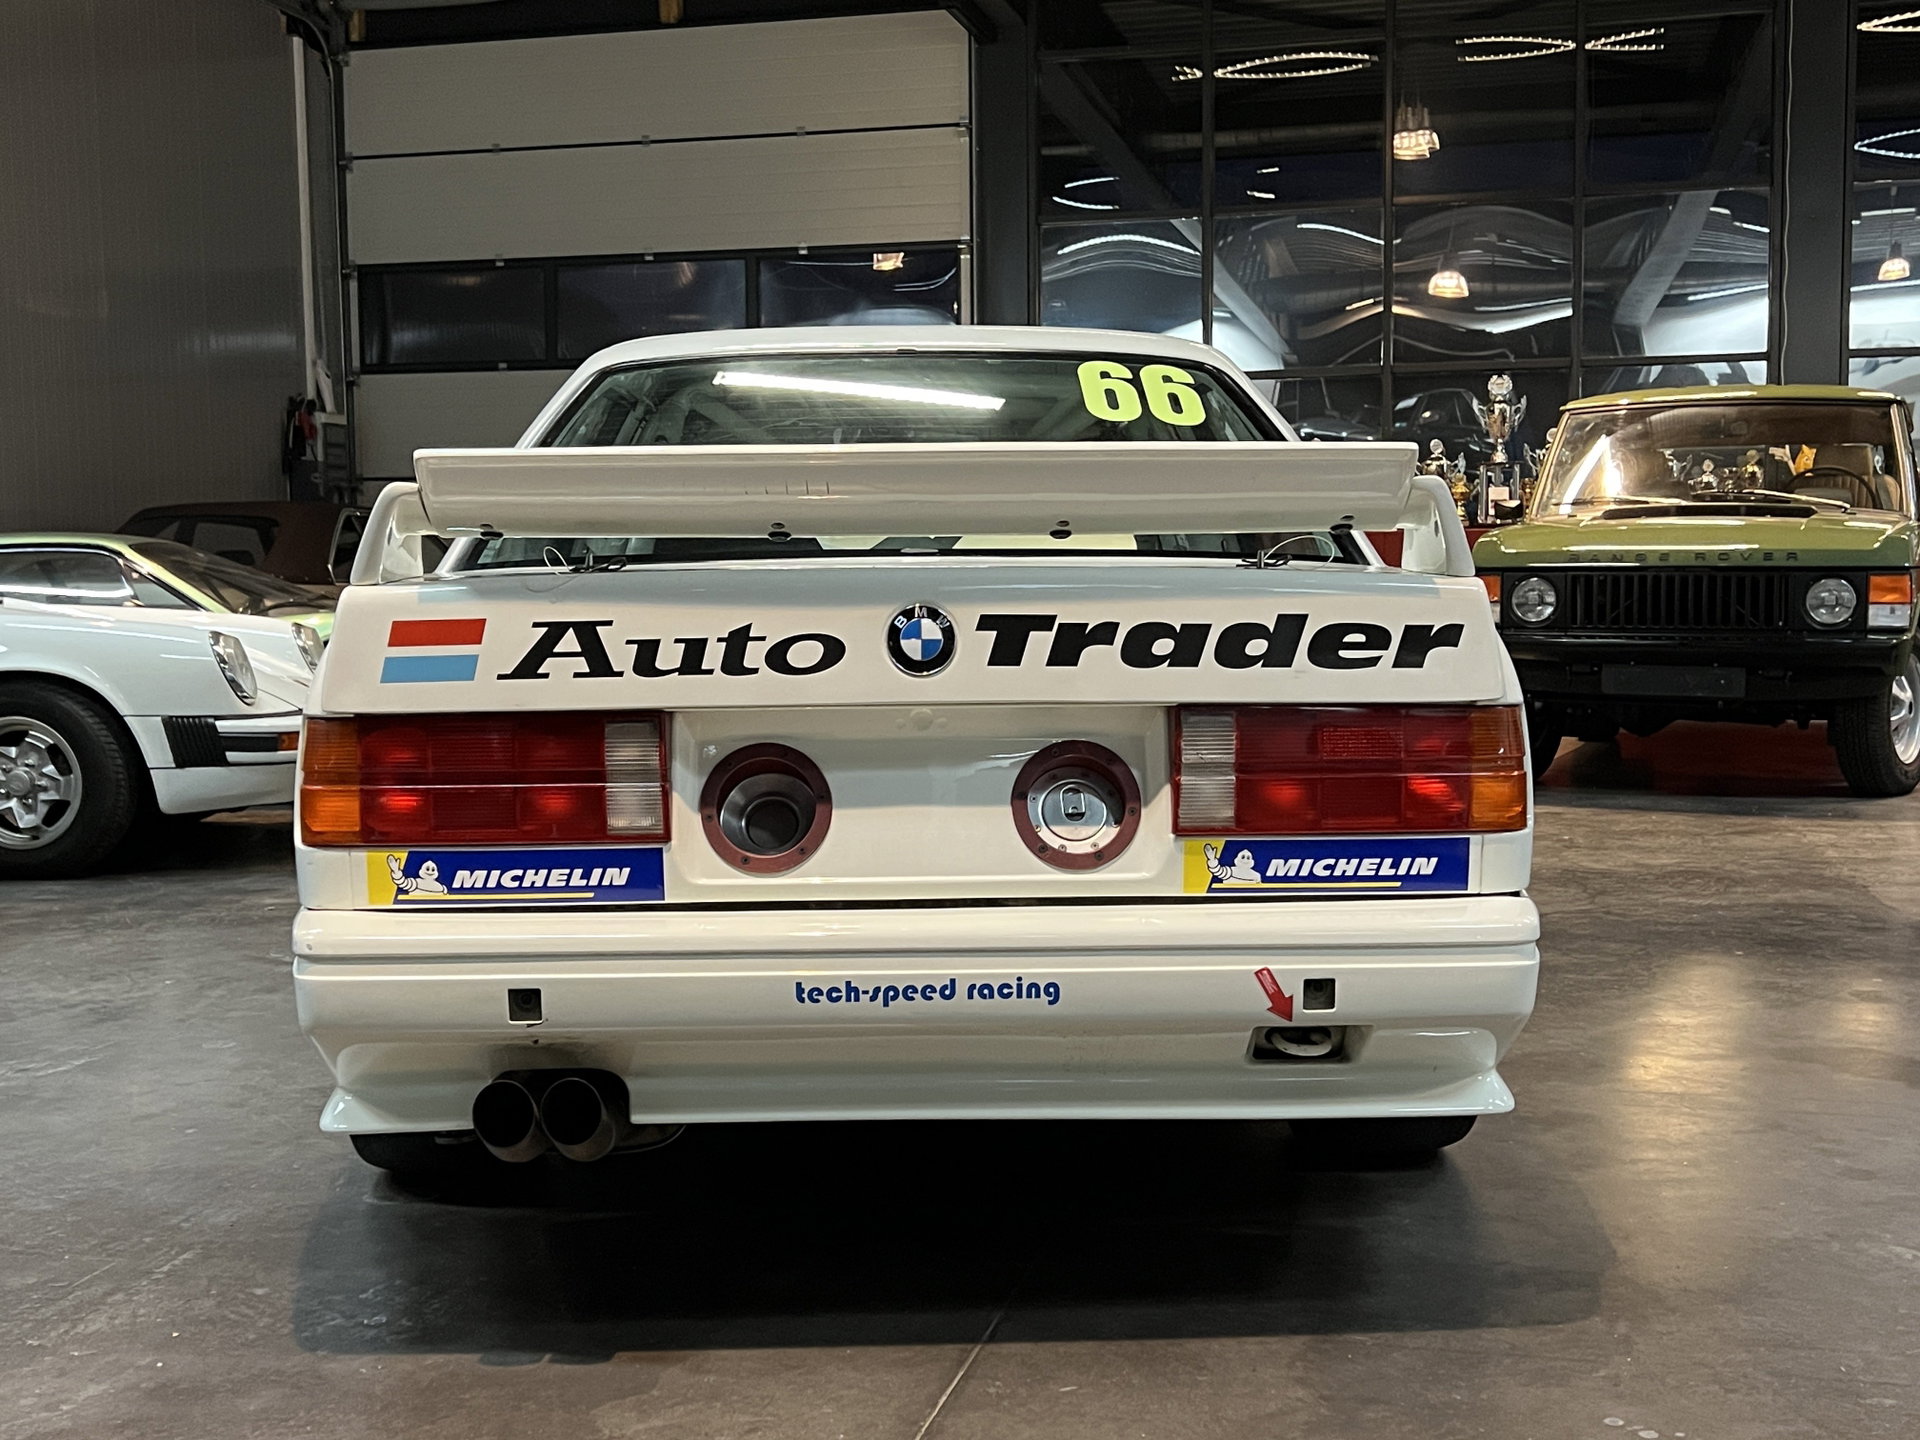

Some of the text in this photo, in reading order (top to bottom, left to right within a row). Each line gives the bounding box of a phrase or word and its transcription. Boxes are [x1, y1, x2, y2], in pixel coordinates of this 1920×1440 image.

[1077, 360, 1206, 426] 66
[1694, 551, 1799, 562] ROVER
[893, 605, 951, 629] BMW
[496, 613, 1464, 680] Auto Trader
[452, 867, 631, 888] MICHELIN
[1266, 857, 1438, 876] MICHELIN
[795, 976, 1061, 1008] tech-speed racing
